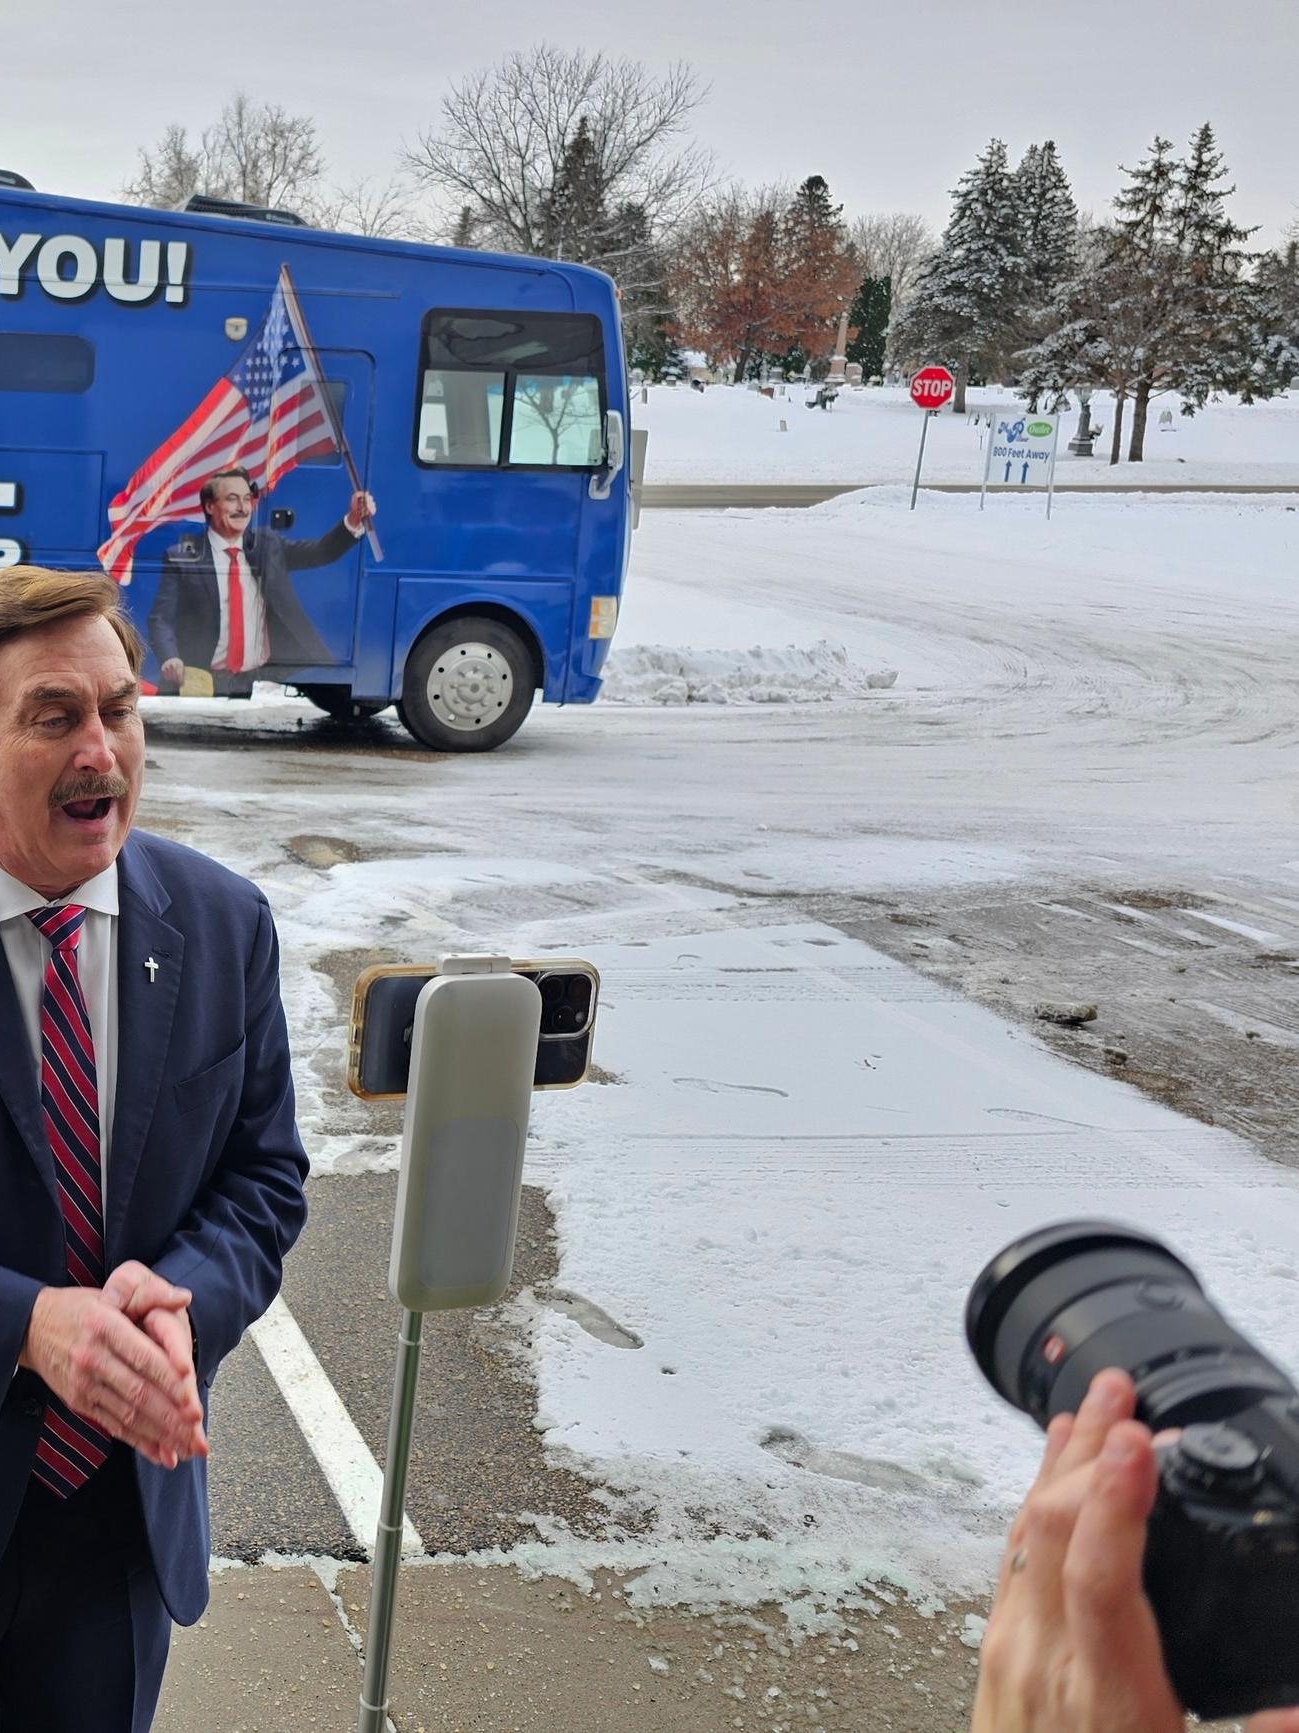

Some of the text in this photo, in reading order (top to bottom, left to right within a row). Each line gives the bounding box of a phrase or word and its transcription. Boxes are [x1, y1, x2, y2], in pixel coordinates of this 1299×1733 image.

[912, 379, 951, 397] STOP
[1008, 447, 1025, 459] Feet
[1025, 449, 1051, 464] Away
